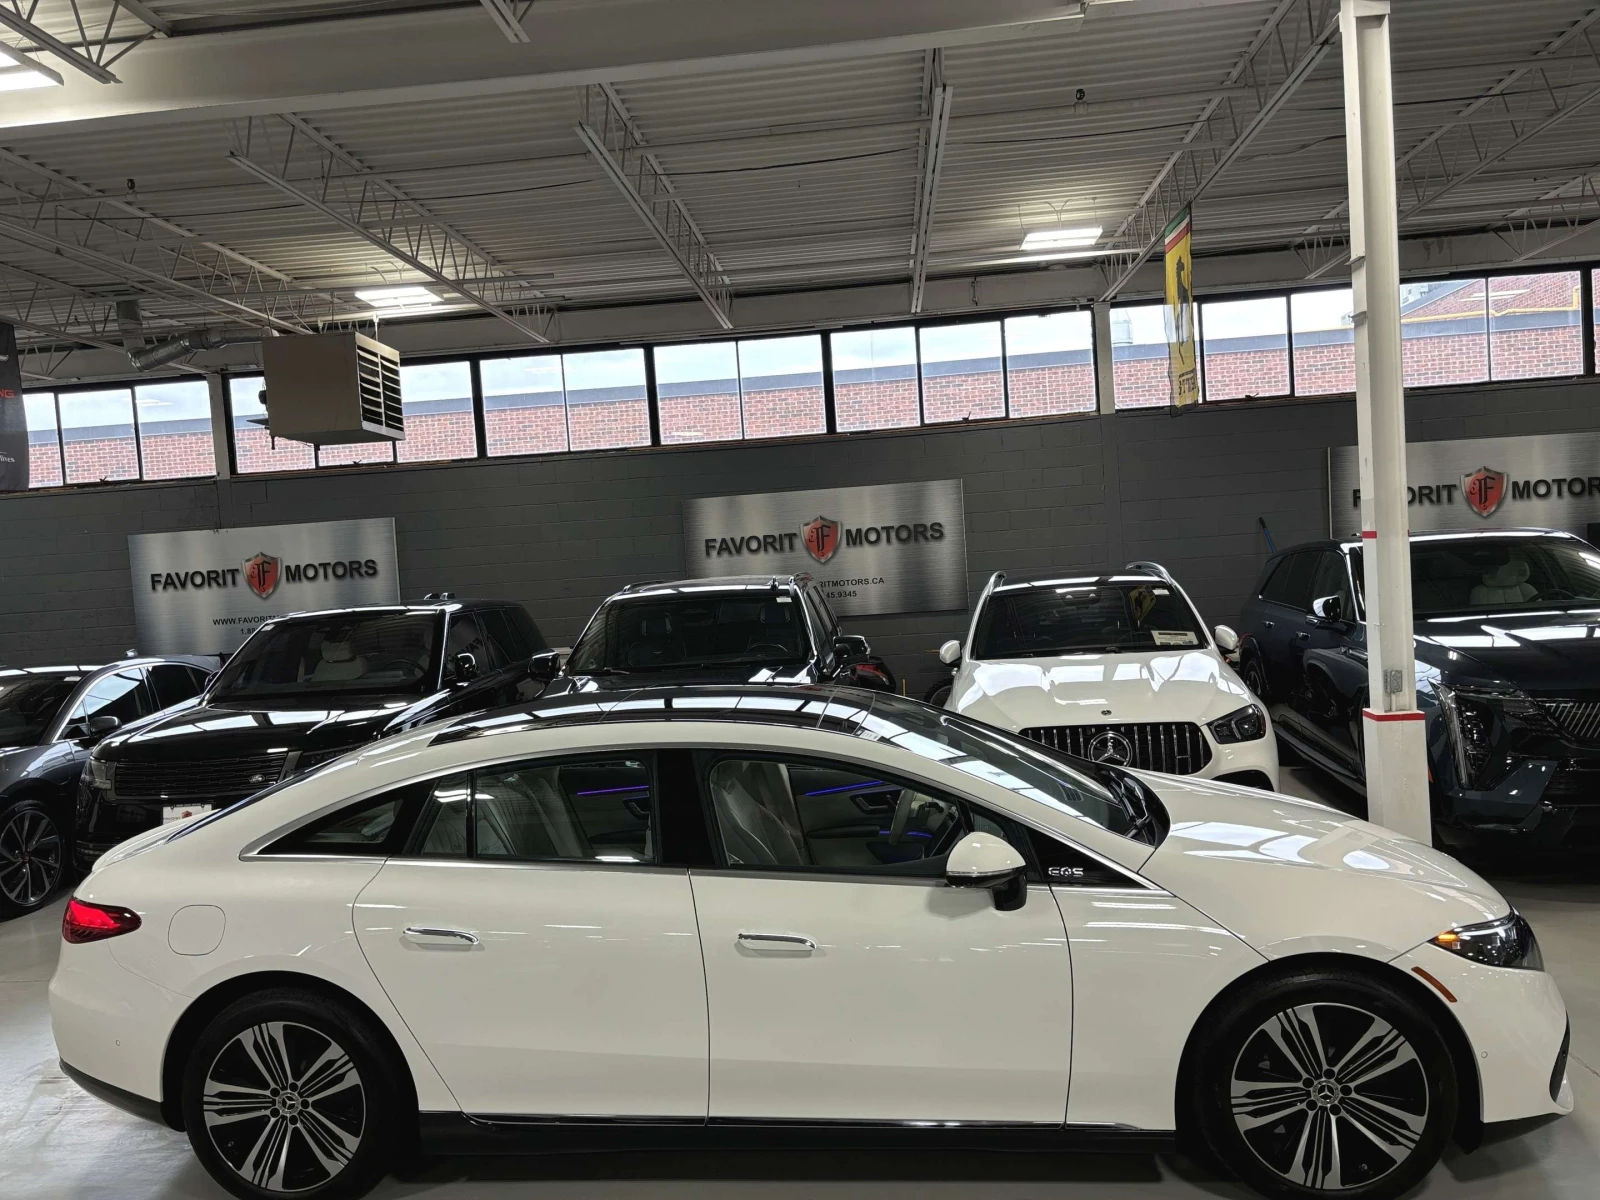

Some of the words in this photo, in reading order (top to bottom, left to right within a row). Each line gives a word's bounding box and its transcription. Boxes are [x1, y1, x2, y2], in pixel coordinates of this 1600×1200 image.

[1353, 484, 1457, 507] FRIT
[1512, 477, 1600, 499] MOTOR
[704, 533, 797, 556] FAVORIT
[845, 522, 944, 546] MOTORS
[151, 569, 239, 590] FAVORIT
[285, 559, 378, 582] MOTORS
[240, 627, 258, 635] 1.88
[1048, 866, 1084, 877] EQS
